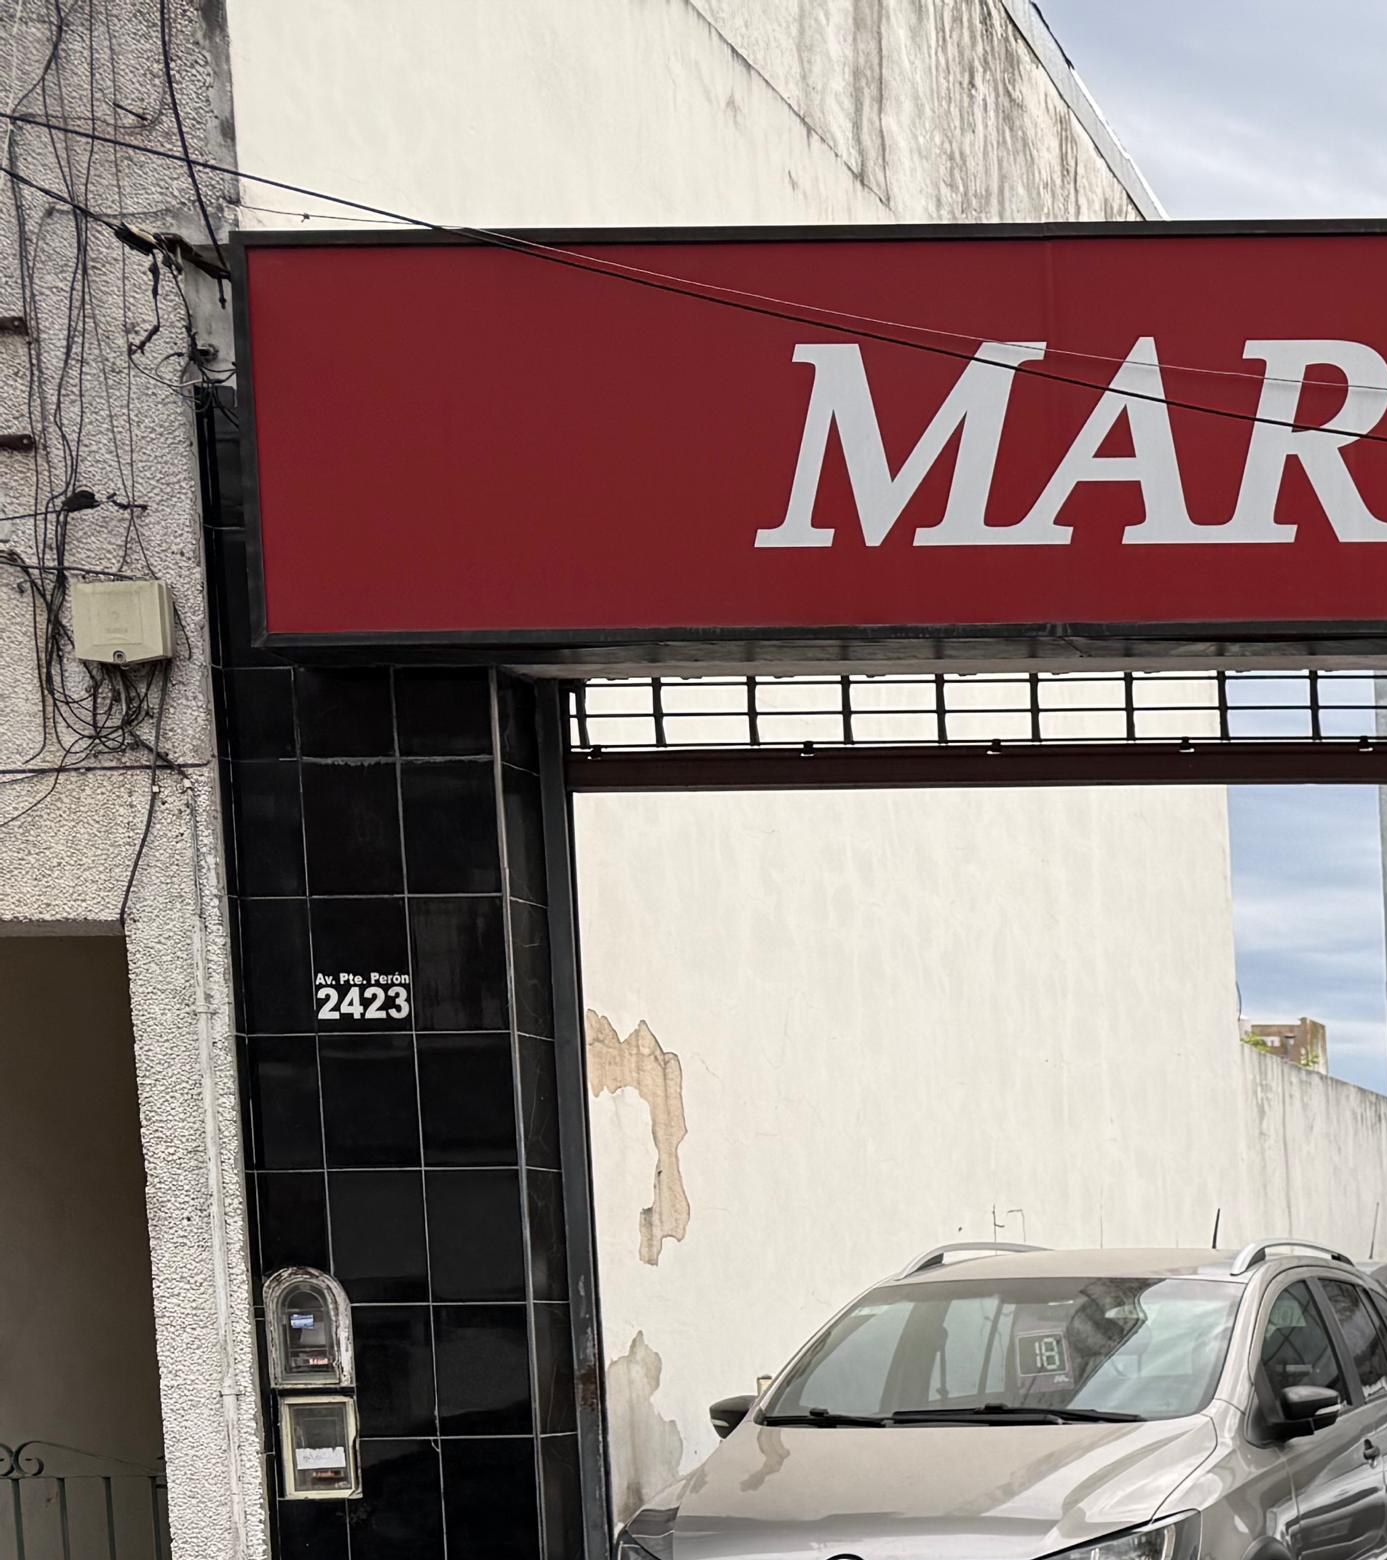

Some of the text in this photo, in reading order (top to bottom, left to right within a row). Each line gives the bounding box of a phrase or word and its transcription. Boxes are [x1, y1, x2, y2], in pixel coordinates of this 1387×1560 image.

[315, 971, 410, 985] Av. Pte. Perón
[316, 986, 410, 1020] 2423
[1034, 1337, 1060, 1370] 18
